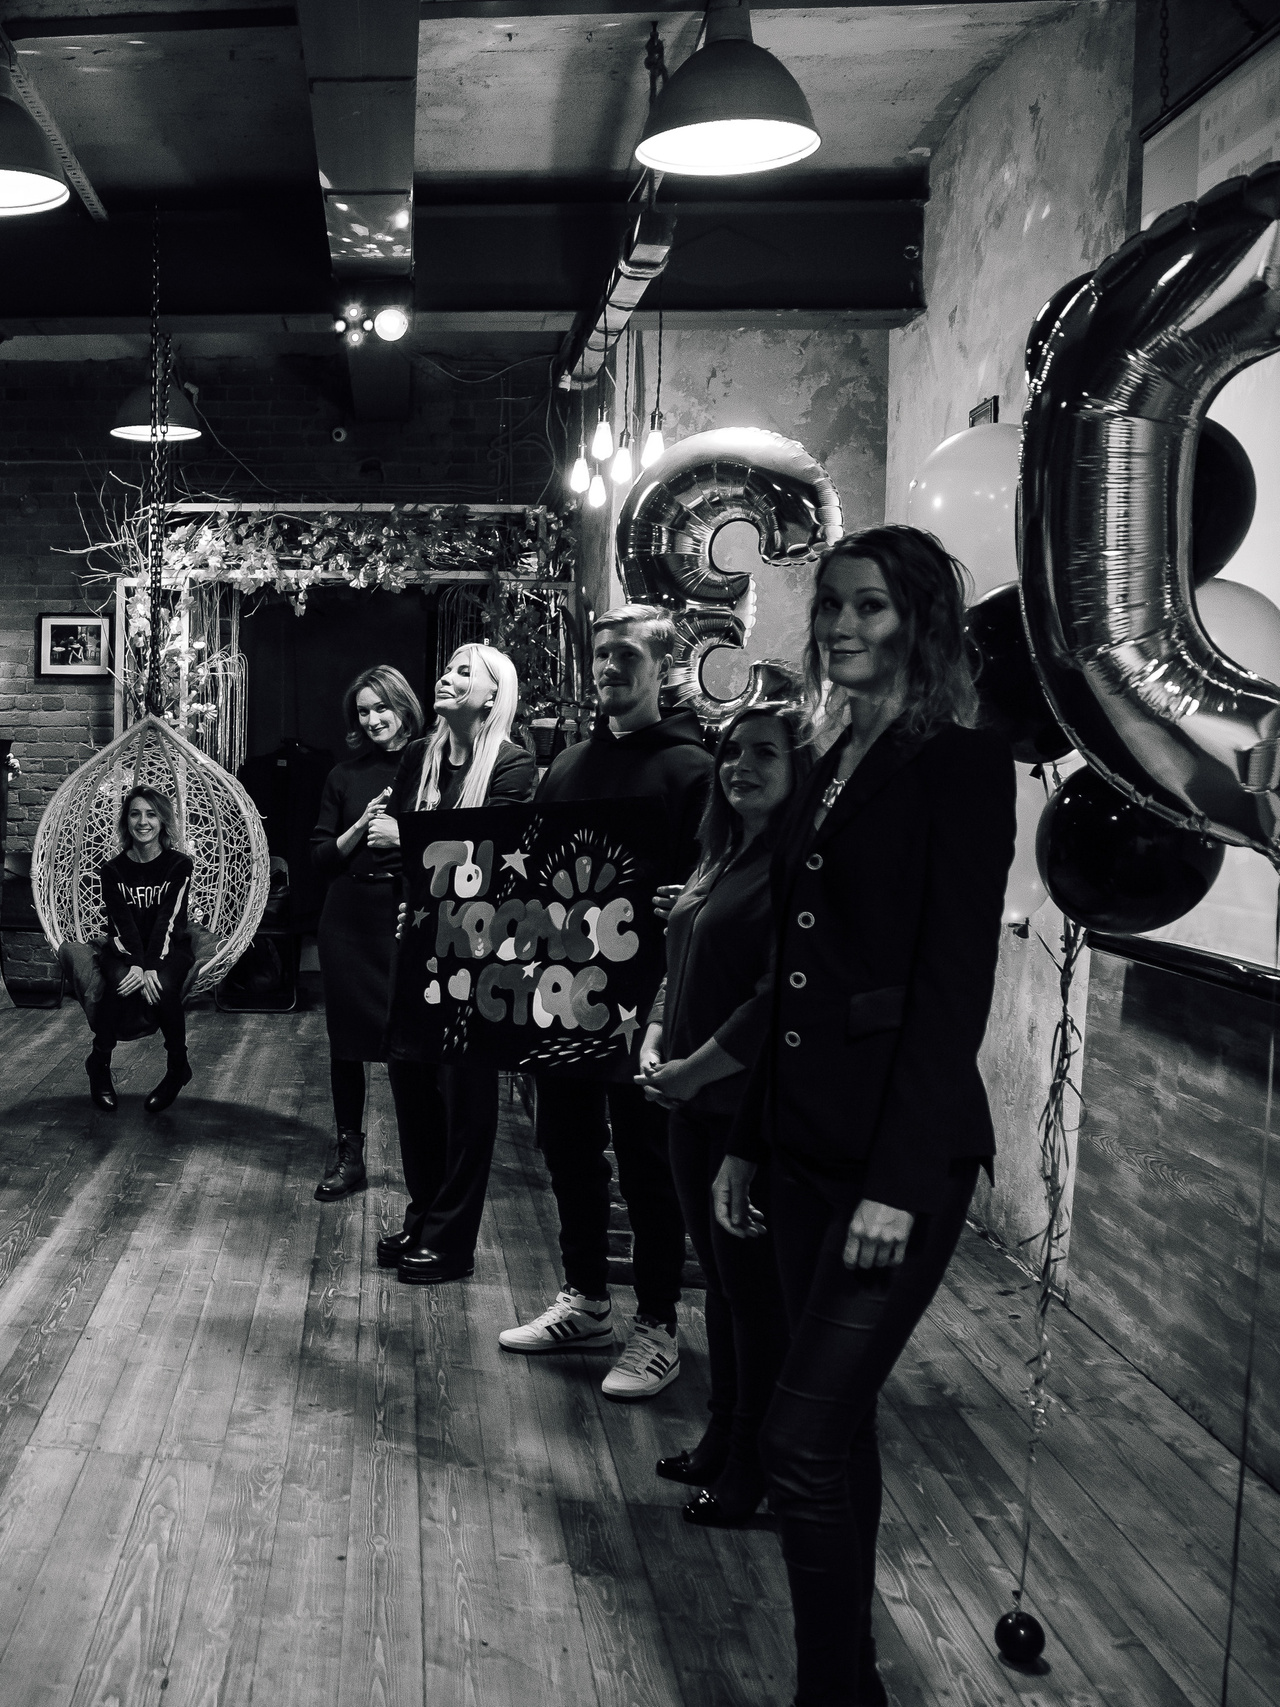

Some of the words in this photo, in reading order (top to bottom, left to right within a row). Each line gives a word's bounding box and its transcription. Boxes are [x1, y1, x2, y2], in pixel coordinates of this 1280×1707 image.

[422, 839, 494, 898] ТЫ
[435, 897, 640, 963] КОСМОС
[476, 963, 610, 1031] СТАС
